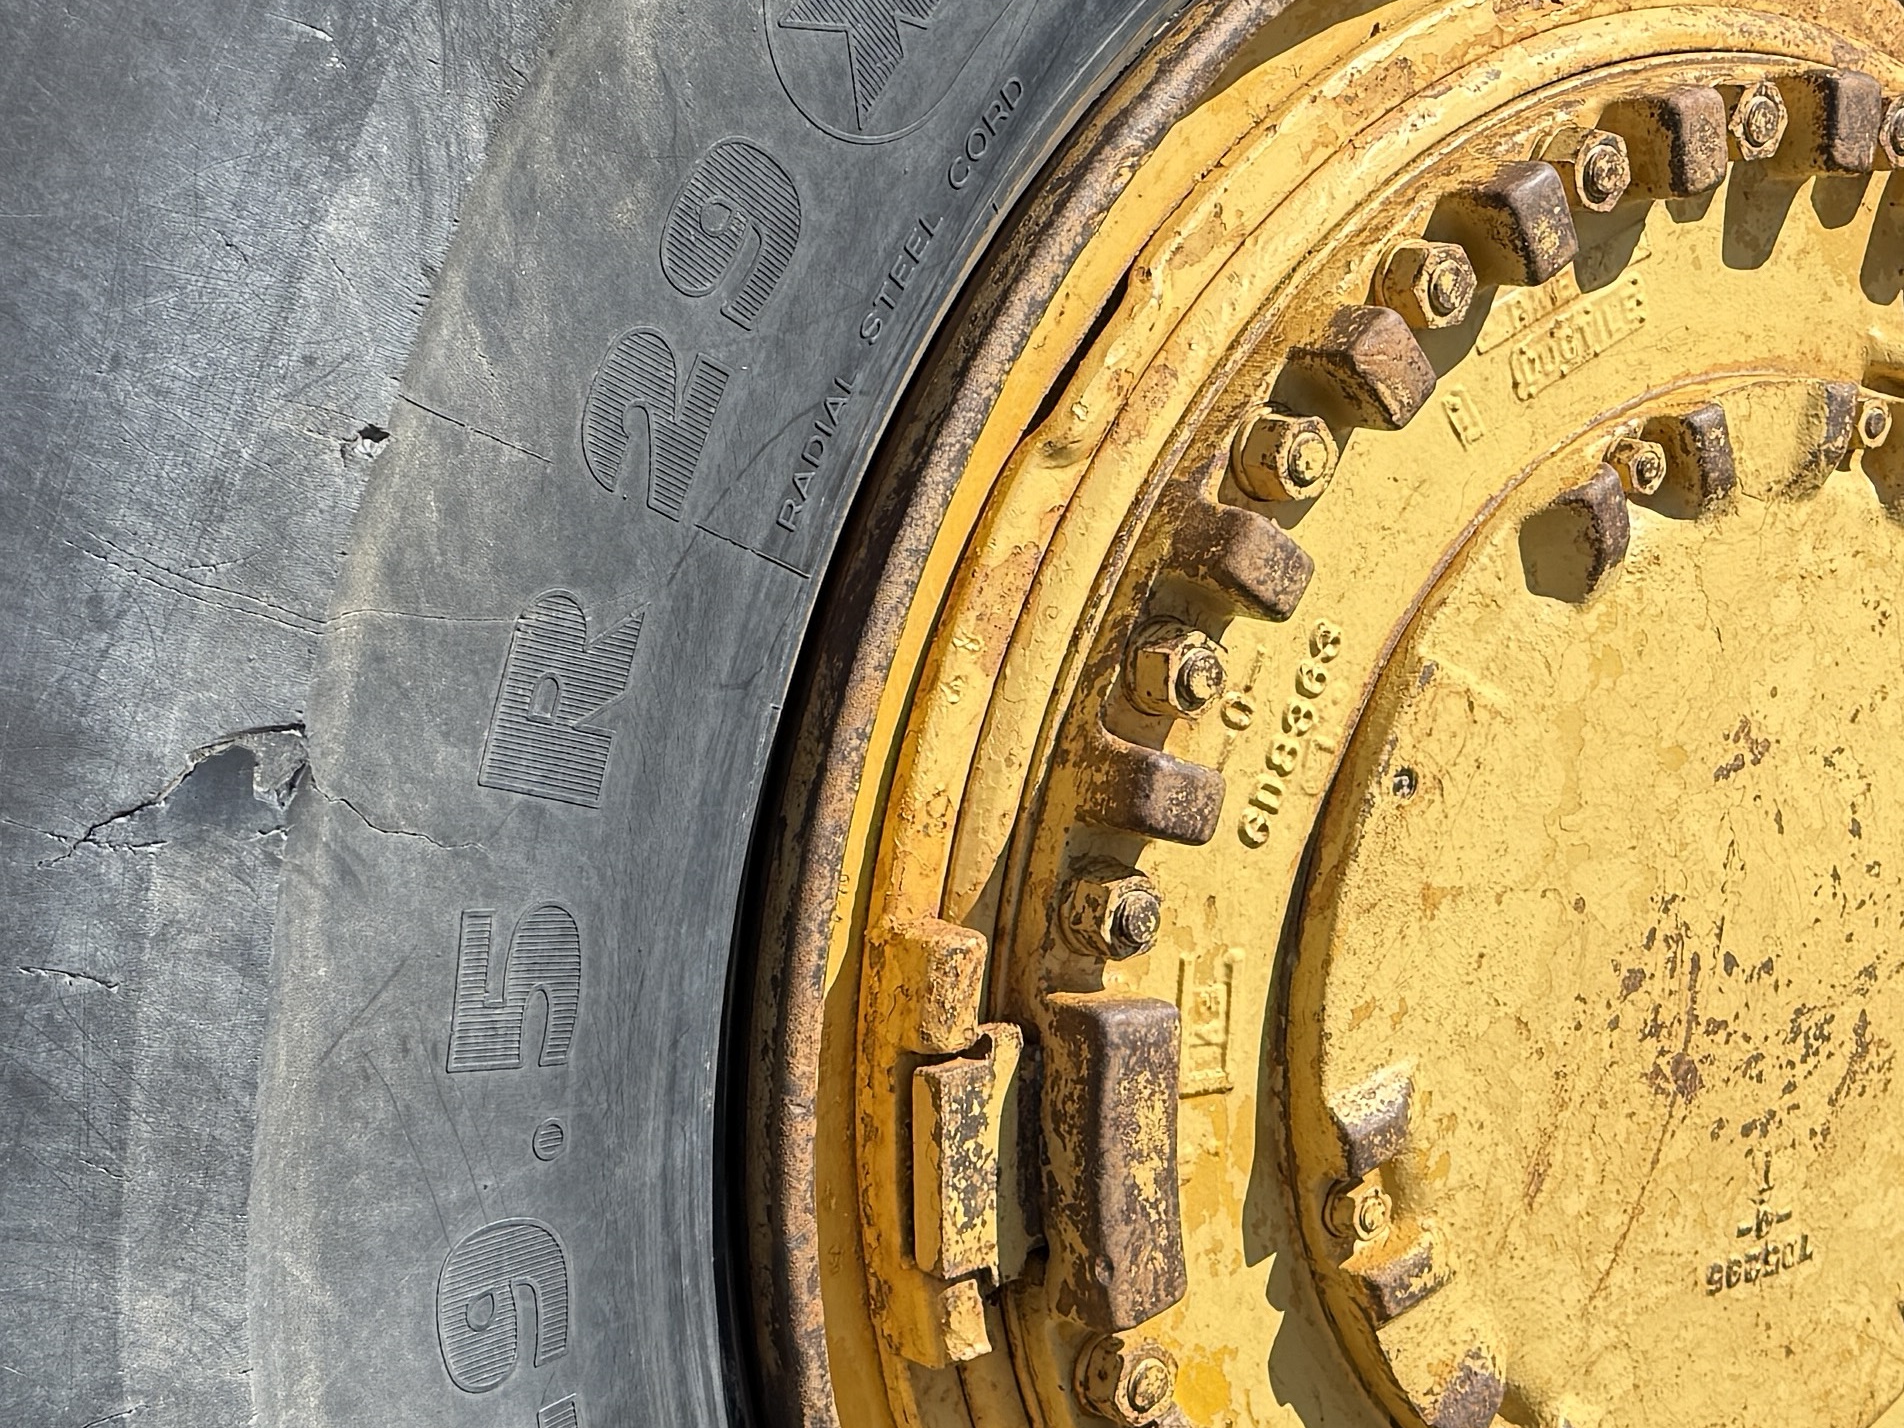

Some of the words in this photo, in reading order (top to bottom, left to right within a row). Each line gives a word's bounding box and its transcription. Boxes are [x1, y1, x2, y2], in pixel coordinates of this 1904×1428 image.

[479, 589, 649, 809] R
[582, 137, 801, 522] 29
[776, 373, 859, 534] RADIAL
[860, 215, 943, 346] STEEL
[947, 77, 1023, 192] CORD
